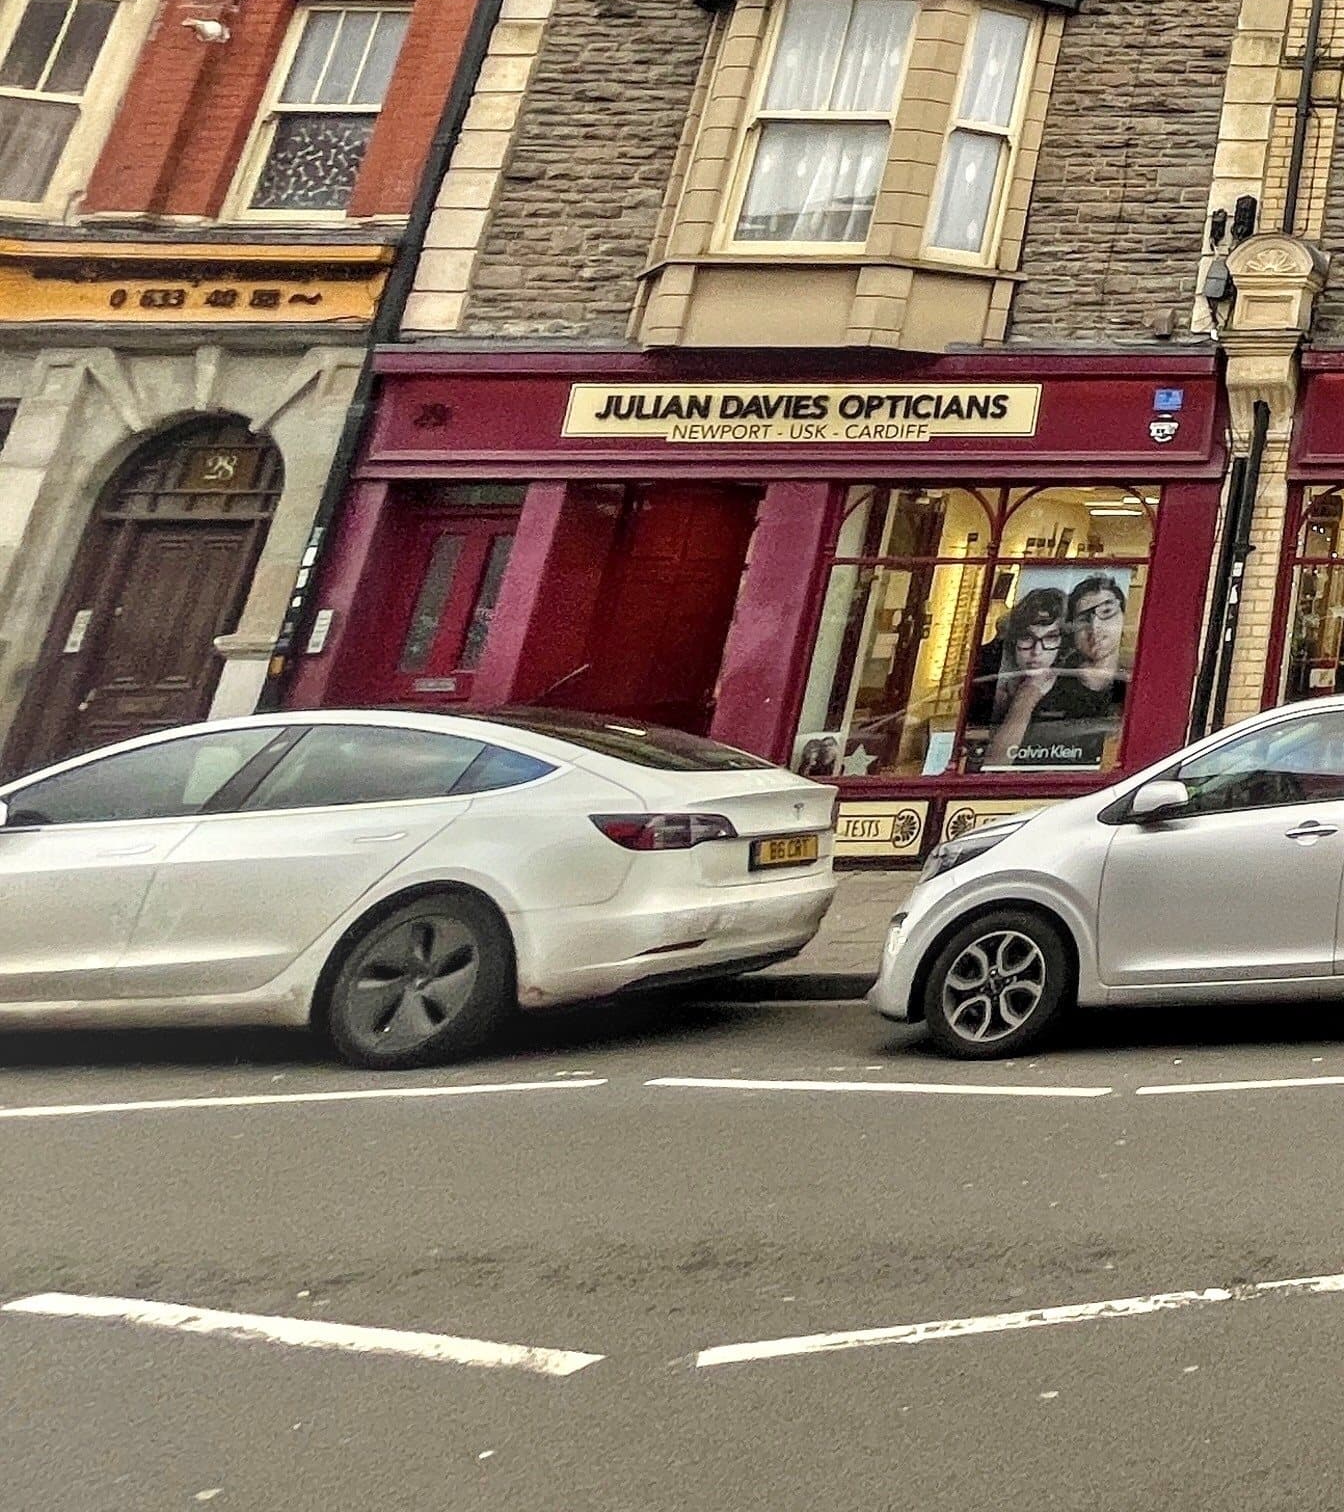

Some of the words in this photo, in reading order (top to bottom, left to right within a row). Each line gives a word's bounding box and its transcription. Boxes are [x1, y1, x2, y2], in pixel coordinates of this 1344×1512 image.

[595, 395, 712, 420] JULIAN
[719, 394, 830, 420] DAVIES
[838, 394, 1009, 420] OPTICIANS
[672, 424, 773, 440] NEWPORT
[790, 424, 828, 439] USK
[845, 424, 928, 439] CARDIFF
[204, 454, 237, 480] 28
[1006, 745, 1049, 759] Calvin
[1051, 745, 1082, 758] Klein
[843, 820, 880, 837] TESTS
